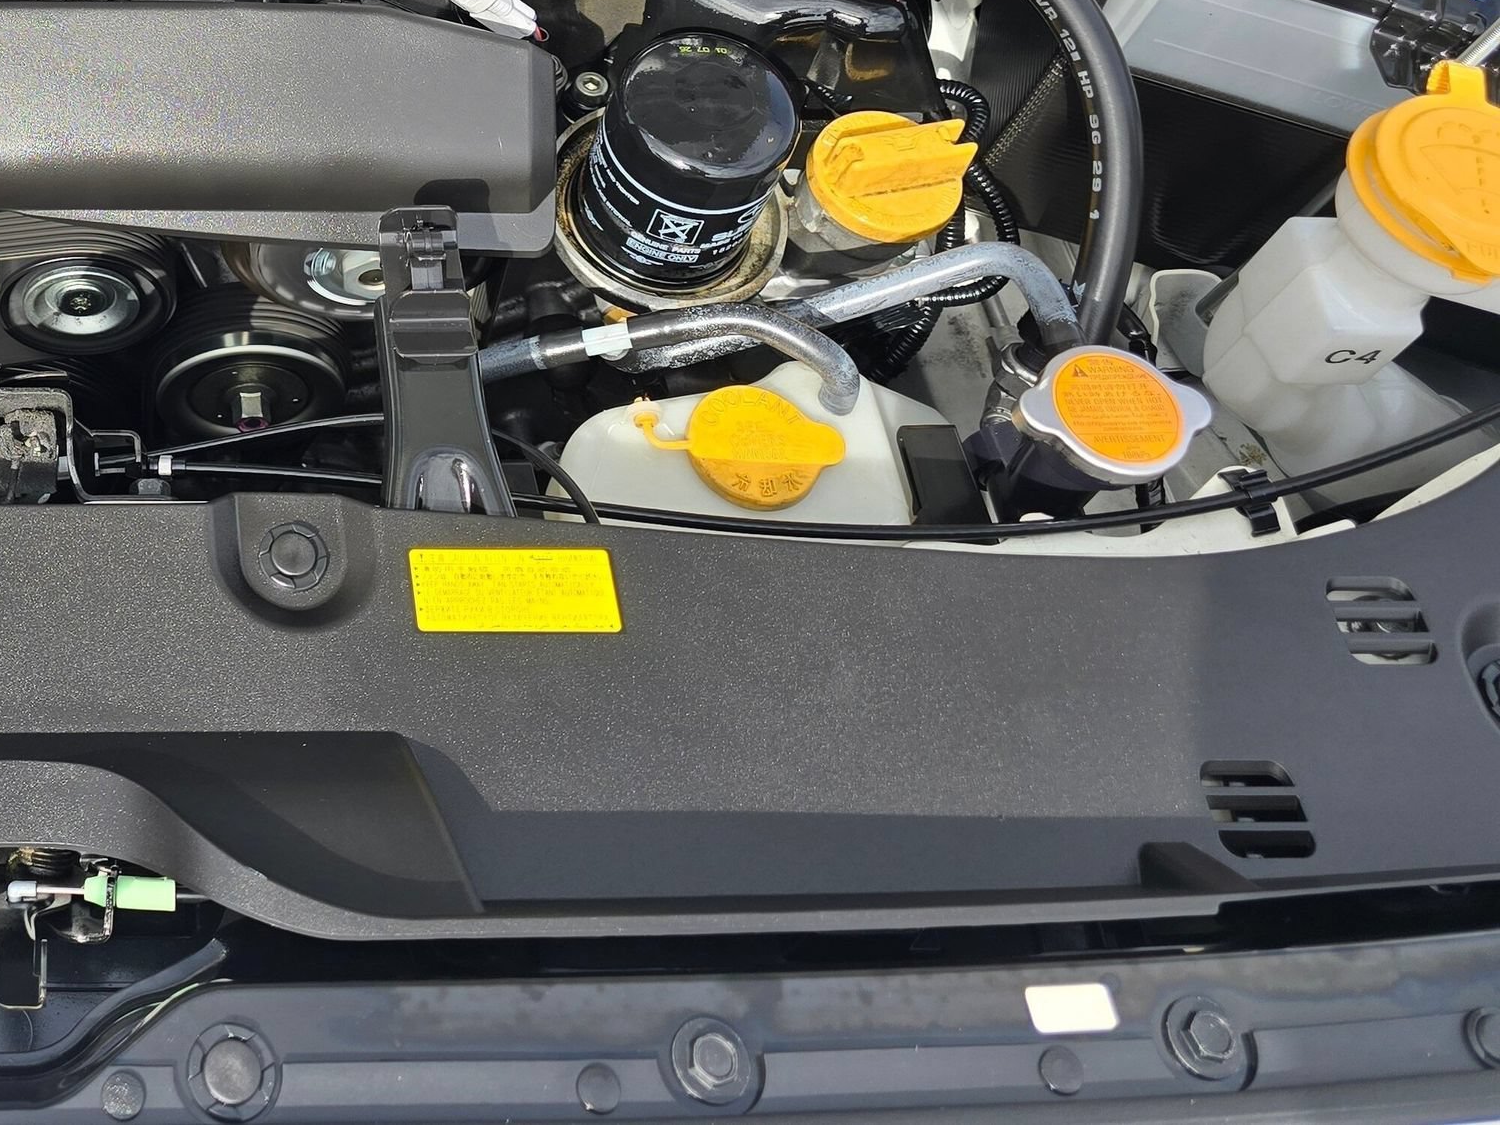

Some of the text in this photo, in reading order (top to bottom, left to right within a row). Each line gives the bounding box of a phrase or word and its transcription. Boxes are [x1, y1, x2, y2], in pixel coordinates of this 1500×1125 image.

[1078, 70, 1095, 99] HP
[627, 237, 698, 263] ENGINE ONLY
[671, 243, 701, 255] PARTS
[1324, 349, 1382, 365] C4
[1086, 365, 1135, 374] WARNING
[701, 390, 804, 425] COOLANT
[1094, 397, 1117, 406] OPEN
[1118, 396, 1144, 406] WHEN
[1093, 433, 1166, 444] AVERTISSEMENT
